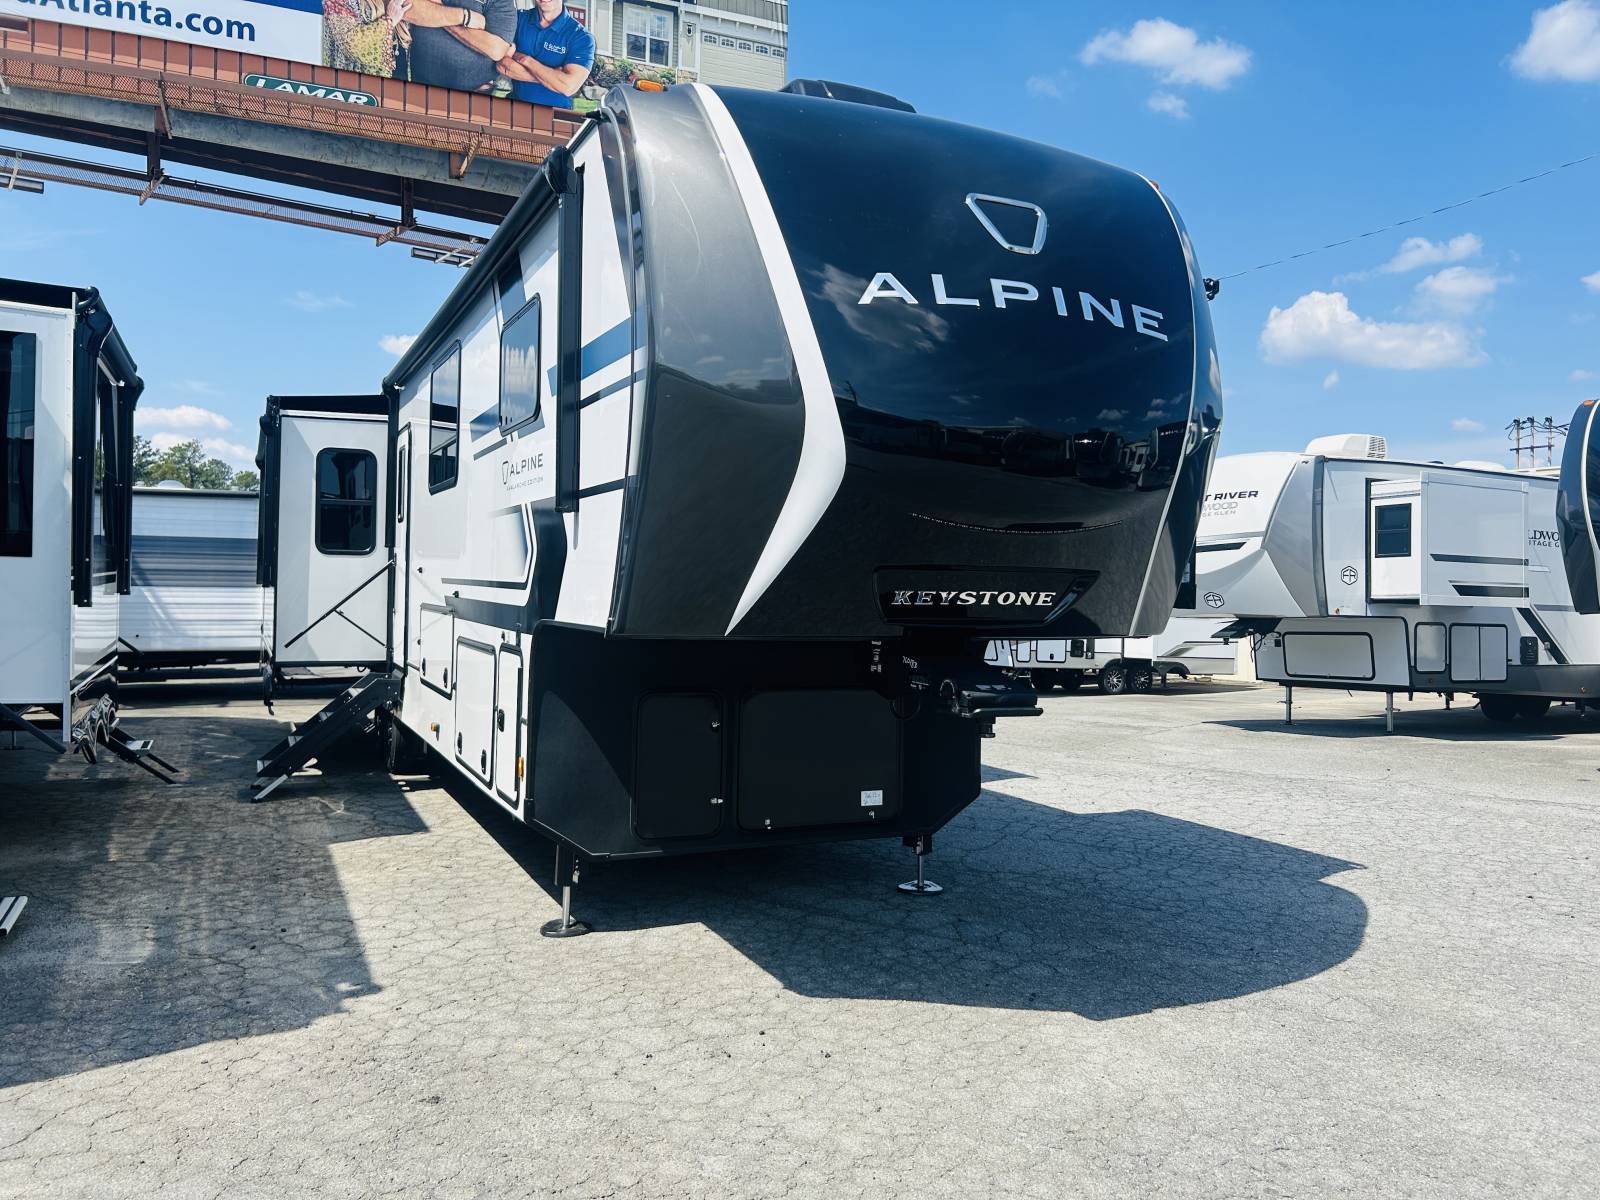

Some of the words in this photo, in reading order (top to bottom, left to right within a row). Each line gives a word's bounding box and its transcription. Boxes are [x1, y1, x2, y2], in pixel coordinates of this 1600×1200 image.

[17, 0, 256, 41] tlanta.com
[858, 272, 1168, 341] ALPINE
[510, 453, 544, 477] ALPINE
[1214, 490, 1259, 501] RIVER
[891, 590, 1057, 606] KEYSTONE
